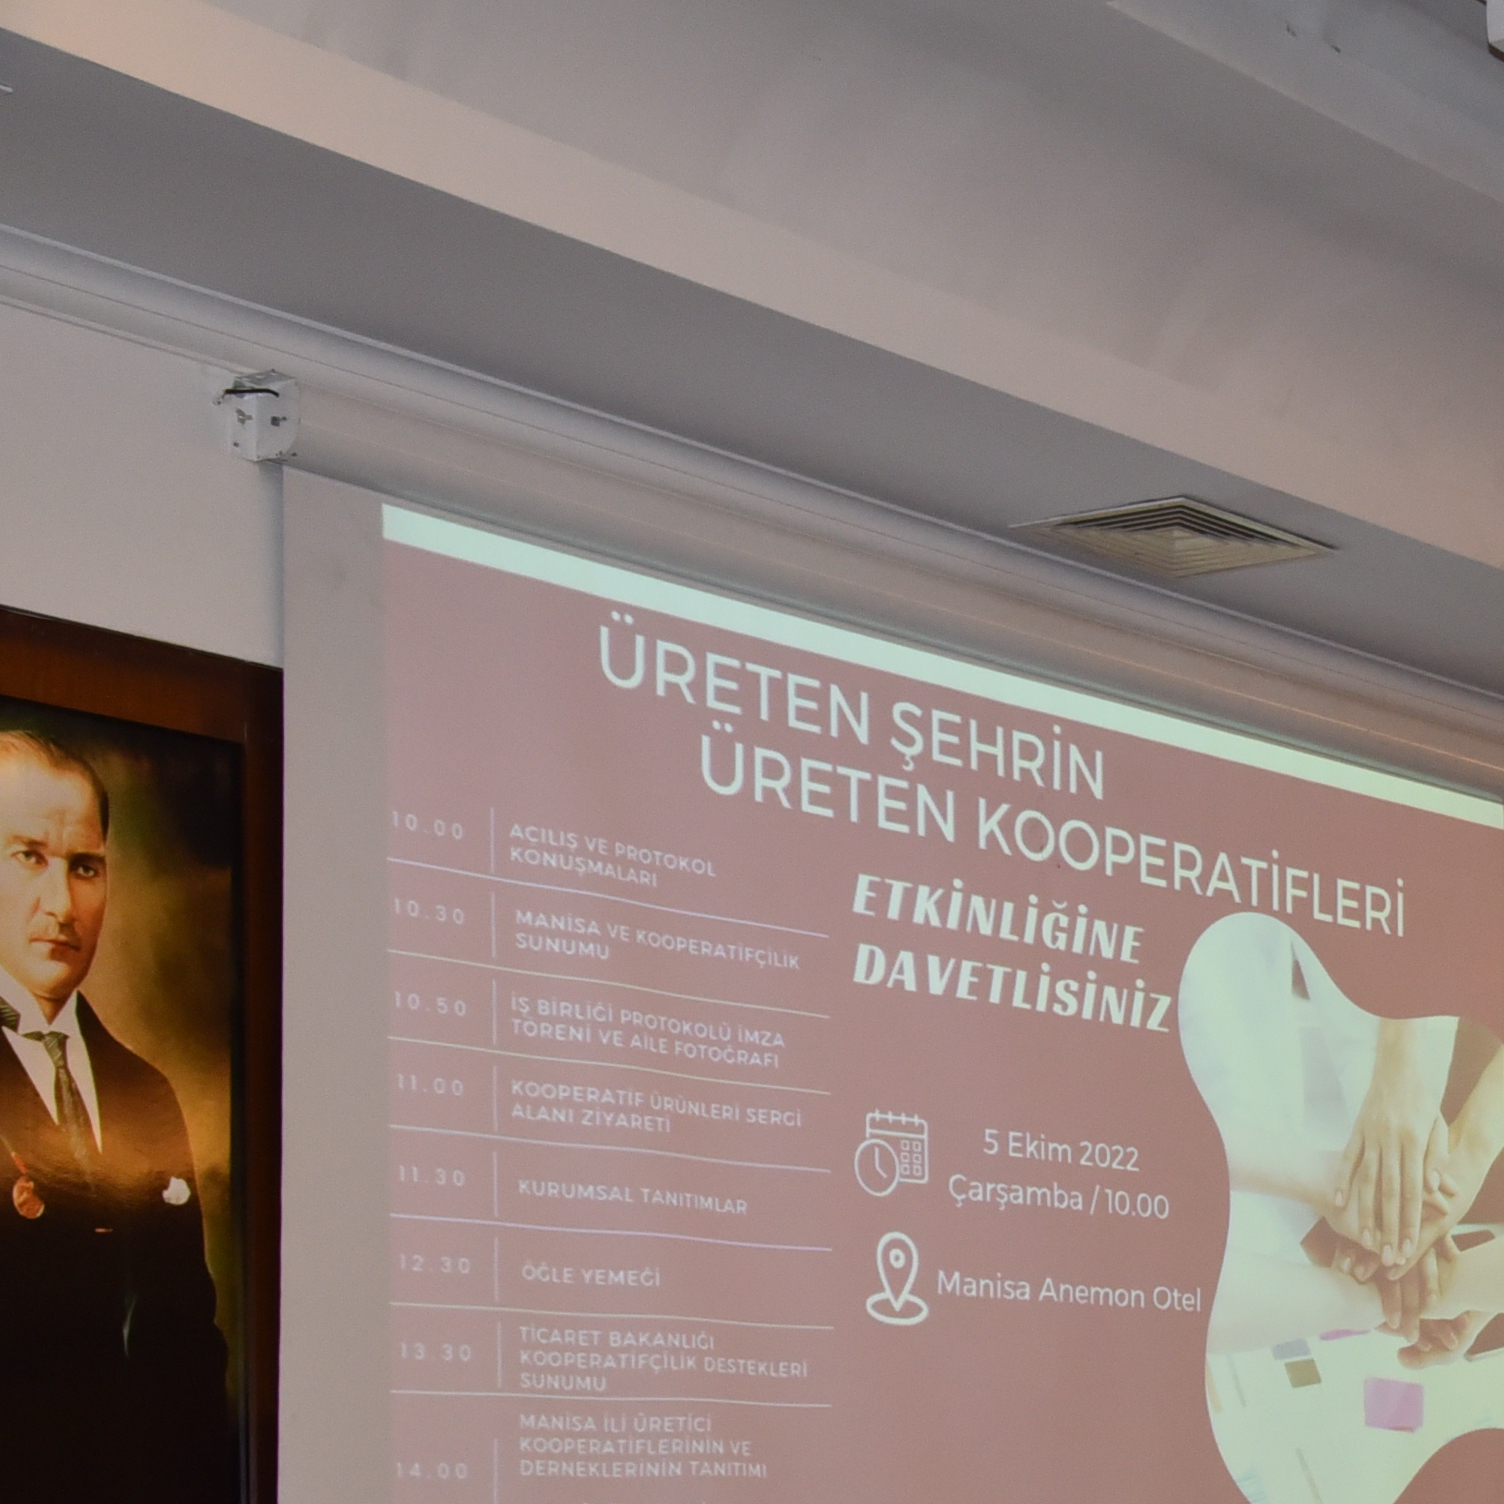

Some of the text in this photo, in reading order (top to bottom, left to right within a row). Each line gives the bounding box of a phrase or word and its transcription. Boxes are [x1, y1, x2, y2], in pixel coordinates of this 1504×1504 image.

[600, 610, 1104, 801] ÜRETEN ŞEHRİN
[391, 811, 463, 840] 10.00
[701, 720, 1405, 937] ÜRETEN KOOPERATİFLERİ
[509, 824, 716, 877] AÇILIŞ VE PROTOKOL
[510, 847, 658, 887] KONUŞMALARI
[393, 897, 465, 925] 10.30
[851, 872, 1145, 965] ETKİNLİĞİNE
[515, 932, 610, 960] SUNUMU
[516, 909, 800, 970] MANİSA VE KOOPERATİFÇİLİK
[853, 943, 1172, 1034] DAVETLİSİNİZ
[511, 991, 785, 1048] İŞ BİRLİĞİ PROTOKOLÜ İMZA
[511, 1016, 779, 1069] TÖRENİ VE AİLE FOTOĞRAFI
[511, 1080, 801, 1128] KOOPERATİF ÜRÜNLERİ SERGİ
[511, 1104, 671, 1133] ALANI ZİYARETİ
[983, 1128, 1140, 1172] 5 Ekim 2022
[518, 1179, 748, 1216] KURUMSAL TANITIMLAR
[948, 1173, 1083, 1211] Çarşamba
[1104, 1188, 1170, 1219] 10.00
[522, 1260, 661, 1287] ÖĞLE YEMEĞİ
[937, 1270, 1201, 1312] Manisa Anemon Otel
[519, 1324, 714, 1351] TİCARET BAKANLIĞI
[519, 1348, 808, 1378] KOOPERATİFÇİLİK DESTEKLERİ
[520, 1372, 607, 1392] SUNUMU
[520, 1412, 597, 1432] MANİSA
[633, 1412, 712, 1433] ÜRETİCİ
[730, 1440, 751, 1456] VE
[520, 1459, 767, 1480] DERNEKLERİNİN TANITIMI
